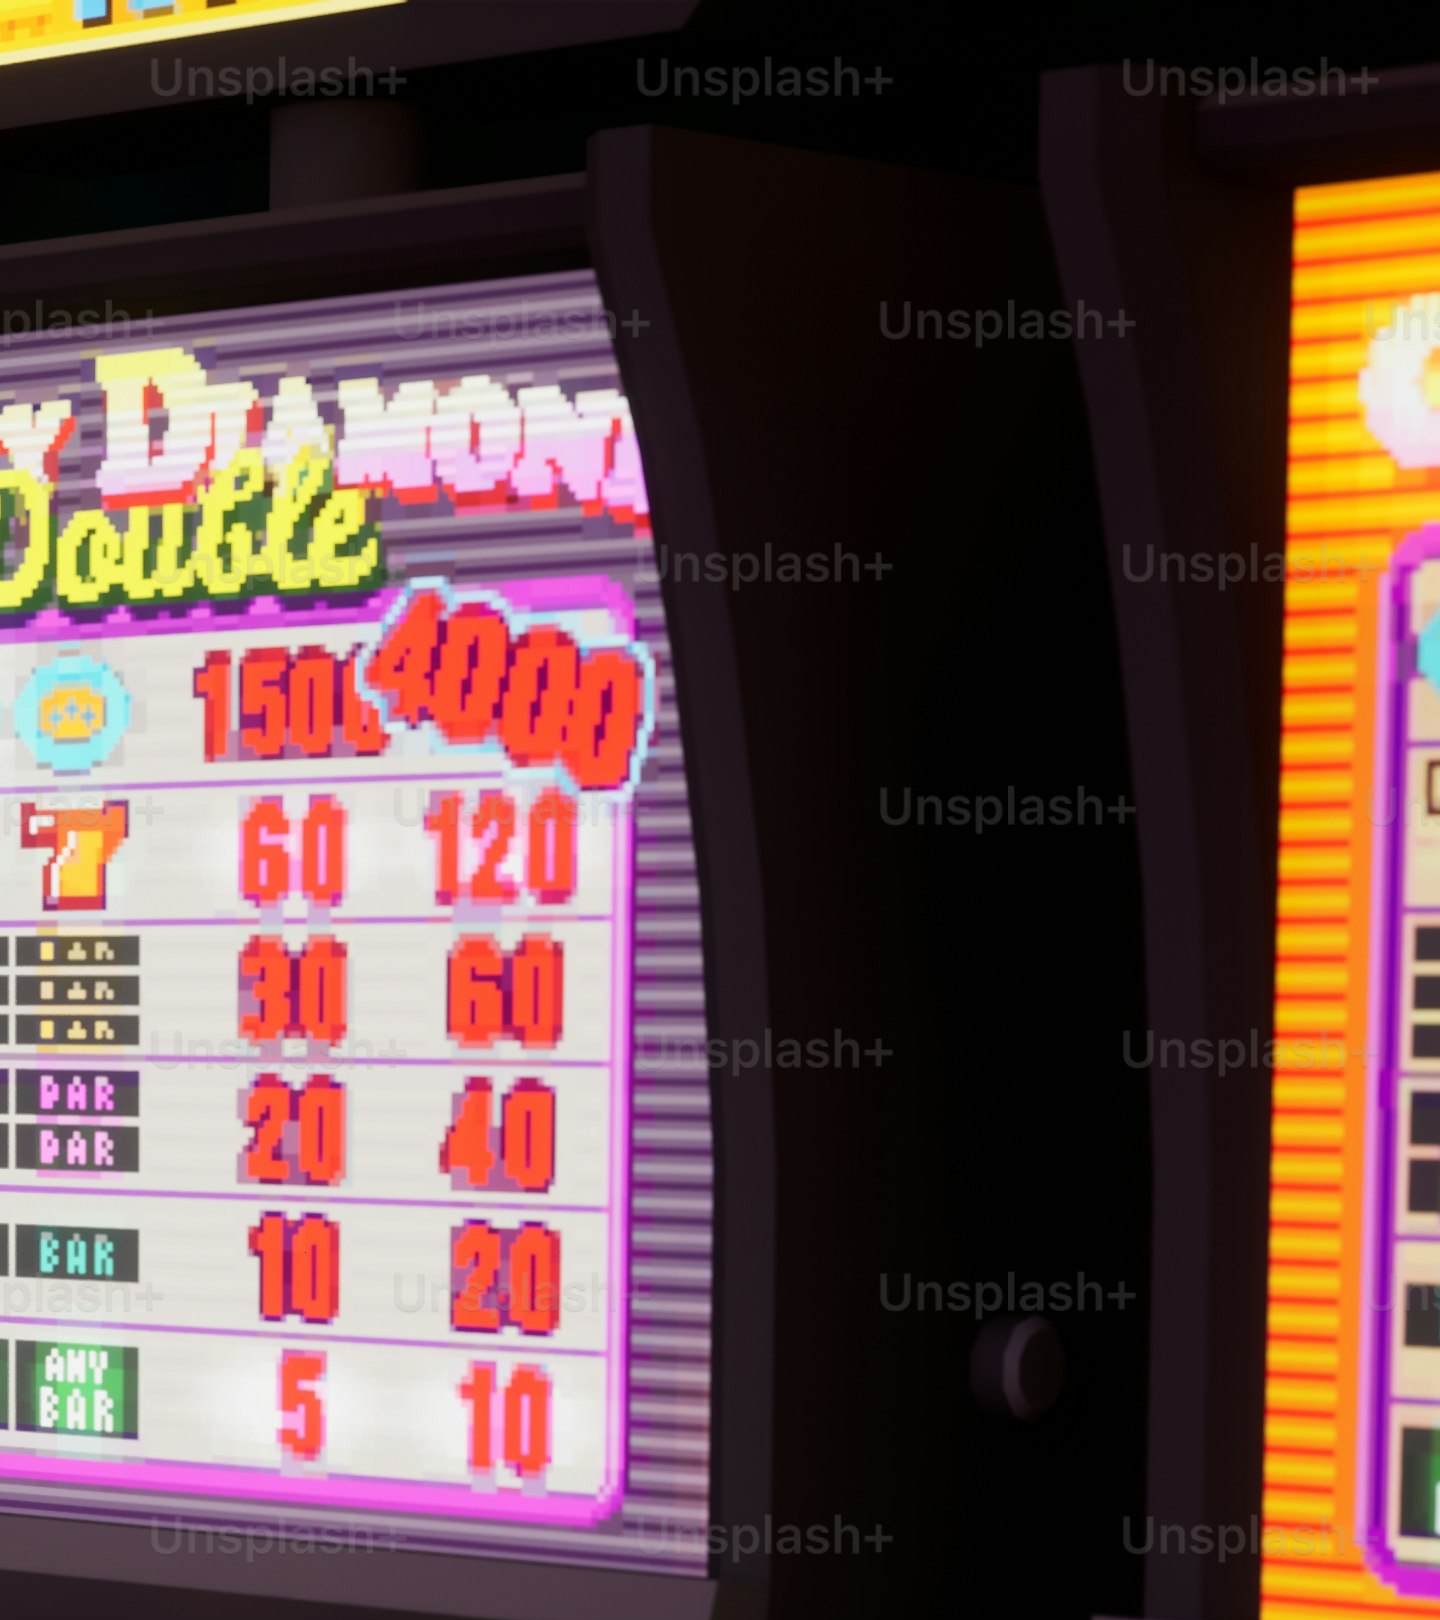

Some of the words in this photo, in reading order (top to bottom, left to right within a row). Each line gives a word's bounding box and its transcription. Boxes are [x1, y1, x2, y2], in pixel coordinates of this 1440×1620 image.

[95, 348, 652, 539] DIAMON
[20, 799, 128, 911] 7
[239, 795, 347, 906] 60
[424, 791, 578, 908] 120
[238, 935, 347, 1047] 30
[445, 933, 564, 1049] 60
[238, 1073, 347, 1186] 20
[440, 1077, 556, 1191] 40
[248, 1211, 340, 1323] 10
[450, 1219, 560, 1334] 20
[278, 1349, 326, 1460] 5
[455, 1360, 552, 1476] 10
